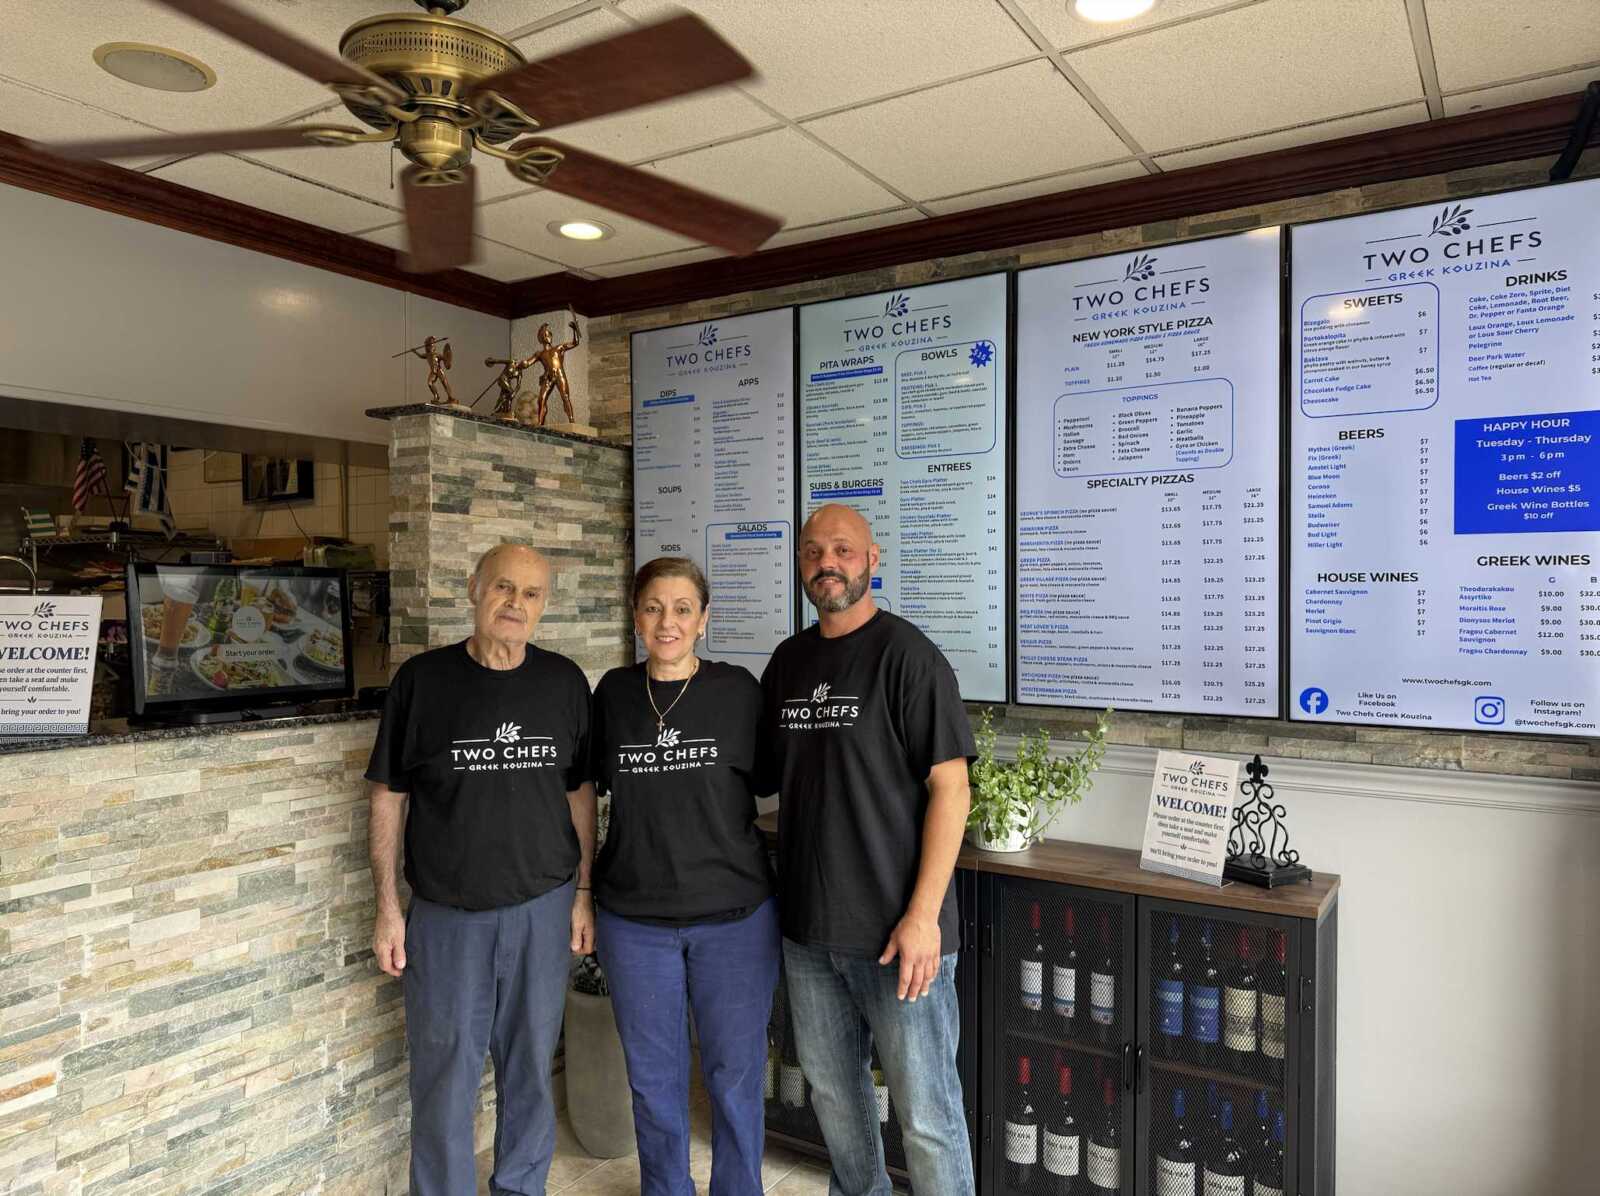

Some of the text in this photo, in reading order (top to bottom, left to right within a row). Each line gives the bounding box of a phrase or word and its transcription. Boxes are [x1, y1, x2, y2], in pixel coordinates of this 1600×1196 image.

[1363, 231, 1542, 270] TWO CHEFS
[1388, 259, 1511, 282] GREEK KOUZINA
[1506, 270, 1567, 287] DRINKS
[1073, 278, 1210, 311] TWO CHEFS
[1344, 293, 1402, 309] SWEETS
[1490, 300, 1530, 308] Lemonade,
[1091, 302, 1186, 321] GREEK KOUZINA
[1536, 315, 1574, 323] Lemonade
[843, 315, 951, 342] TWO CHEFS
[1073, 317, 1213, 343] NEW YORK STYLE PIZZA
[891, 337, 933, 347] KOUZINA
[666, 345, 751, 368] TWO CHEFS
[921, 349, 958, 361] BOWLS
[820, 356, 874, 370] PITA WRAPS
[738, 378, 759, 387] APPS
[660, 389, 676, 398] DIPS
[1122, 394, 1158, 403] TOPPINGS
[1484, 418, 1570, 432] HAPPY HOUR
[1339, 428, 1384, 440] BEERS
[1476, 434, 1591, 448] Tuesday Thursday
[928, 462, 972, 473] ENTREES
[1531, 471, 1543, 480] $2
[810, 482, 832, 490] SUBS
[841, 479, 884, 488] BURGERS
[1087, 474, 1194, 489] SPECIALTY PIZZAS
[658, 484, 682, 494] SOUPS
[1532, 485, 1565, 494] Wines
[1568, 484, 1580, 493] $5
[1551, 500, 1589, 508] Bottles
[737, 524, 767, 532] SALADS
[1477, 555, 1590, 566] GREEK WINES
[1318, 572, 1418, 582] HOUSE WINES
[39, 621, 89, 631] CHEFS
[1402, 676, 1492, 687] www.twochefsgk.com
[781, 706, 859, 719] TWO CHEFS
[1534, 708, 1581, 716] Instagram!
[1515, 719, 1595, 729] @twochefsgk.com
[451, 746, 557, 761] TWO CHEFS
[618, 747, 718, 764] TWO CHEFS
[663, 762, 701, 771] KOUZINA
[1162, 773, 1228, 791] TWO CHEFS
[1157, 795, 1227, 818] WELCOME!
